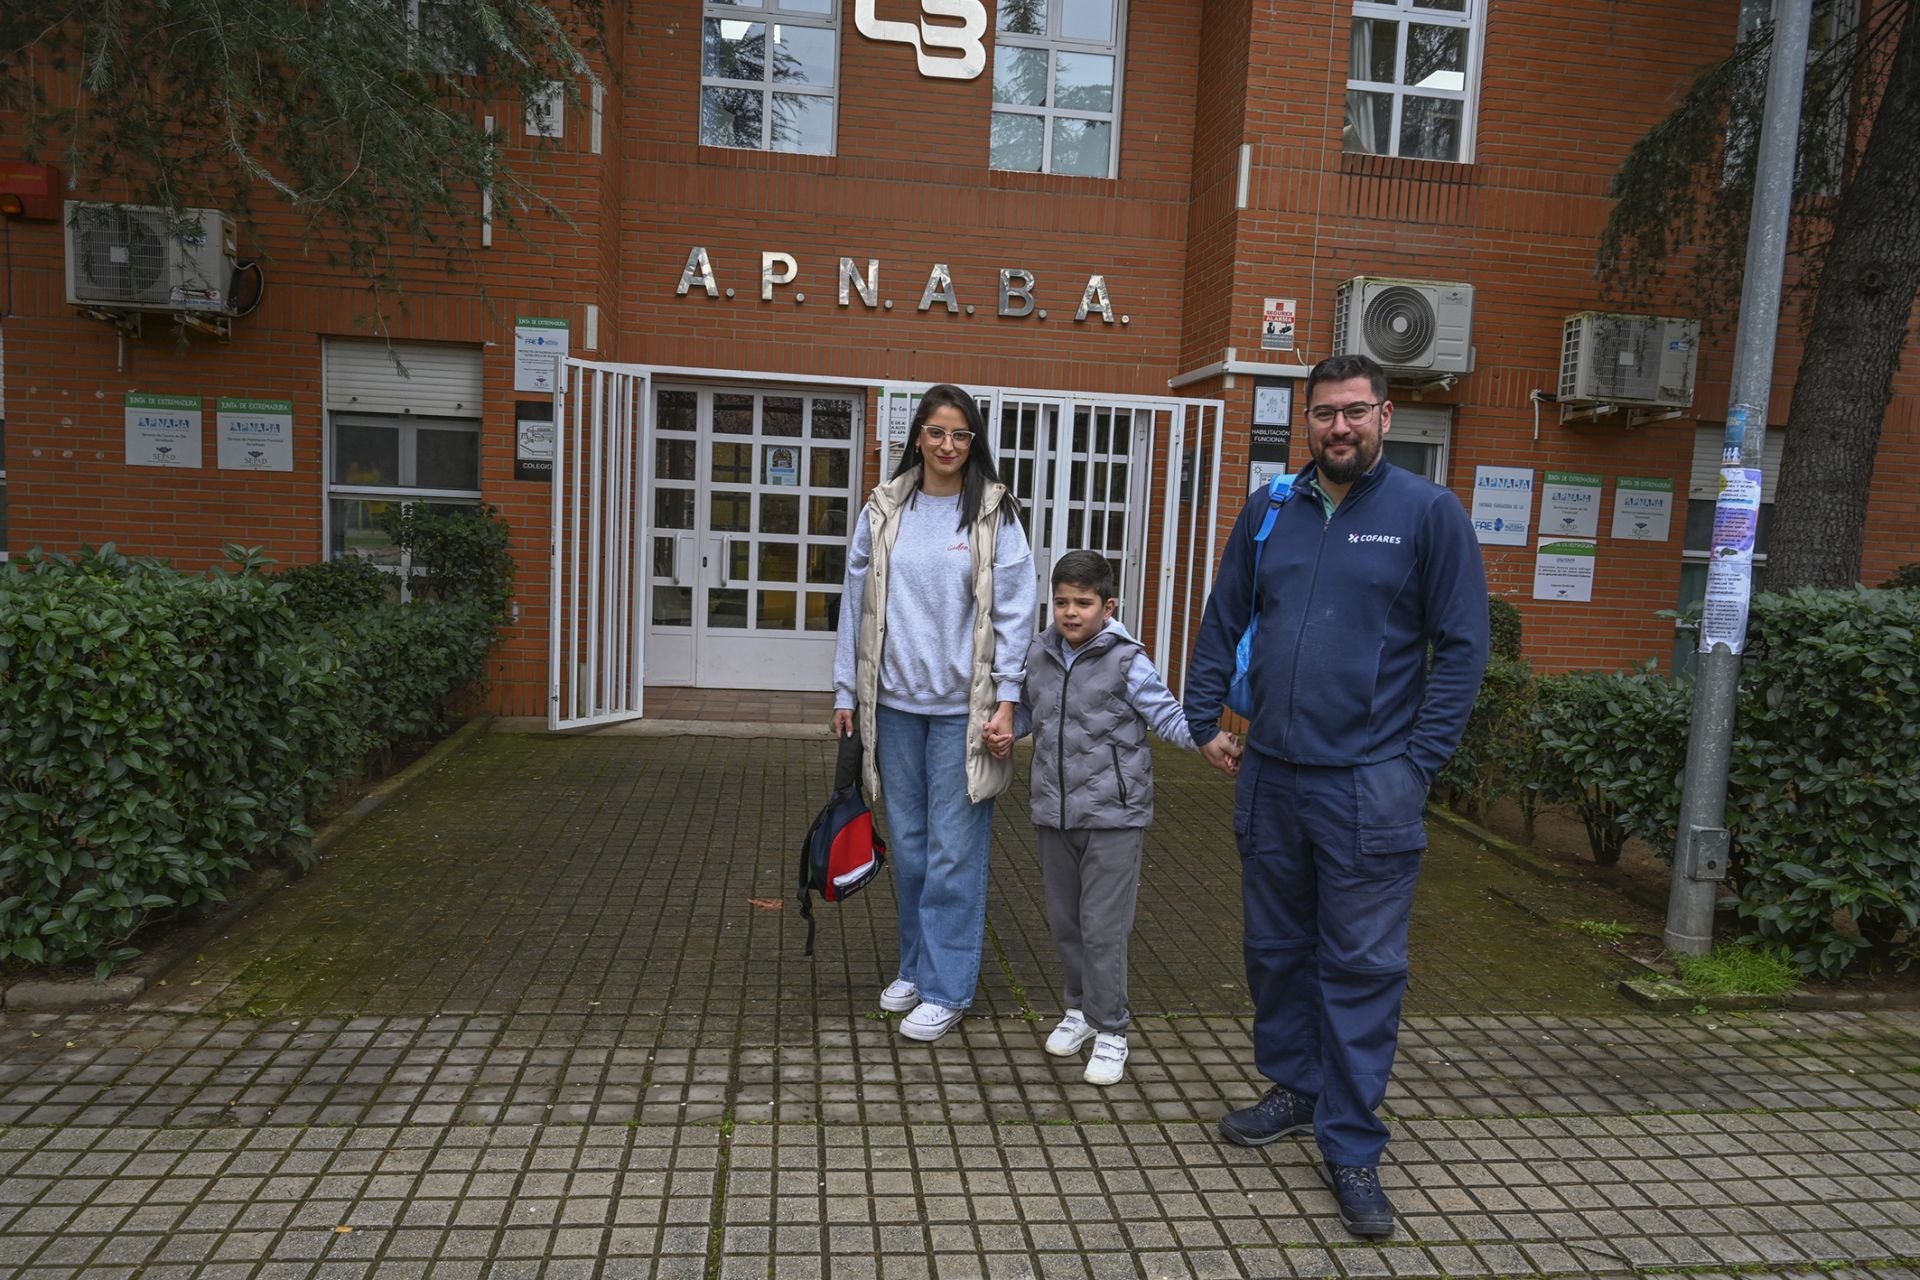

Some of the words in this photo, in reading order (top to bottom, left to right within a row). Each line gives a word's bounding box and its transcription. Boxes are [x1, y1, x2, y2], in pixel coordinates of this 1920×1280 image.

[158, 398, 198, 407] EXTREMADURA
[1254, 435, 1287, 443] FUNCIONAL
[523, 462, 552, 470] COLEGIO
[1478, 477, 1530, 489] APNABA
[1475, 521, 1493, 531] FAE
[1360, 534, 1401, 544] COFARES
